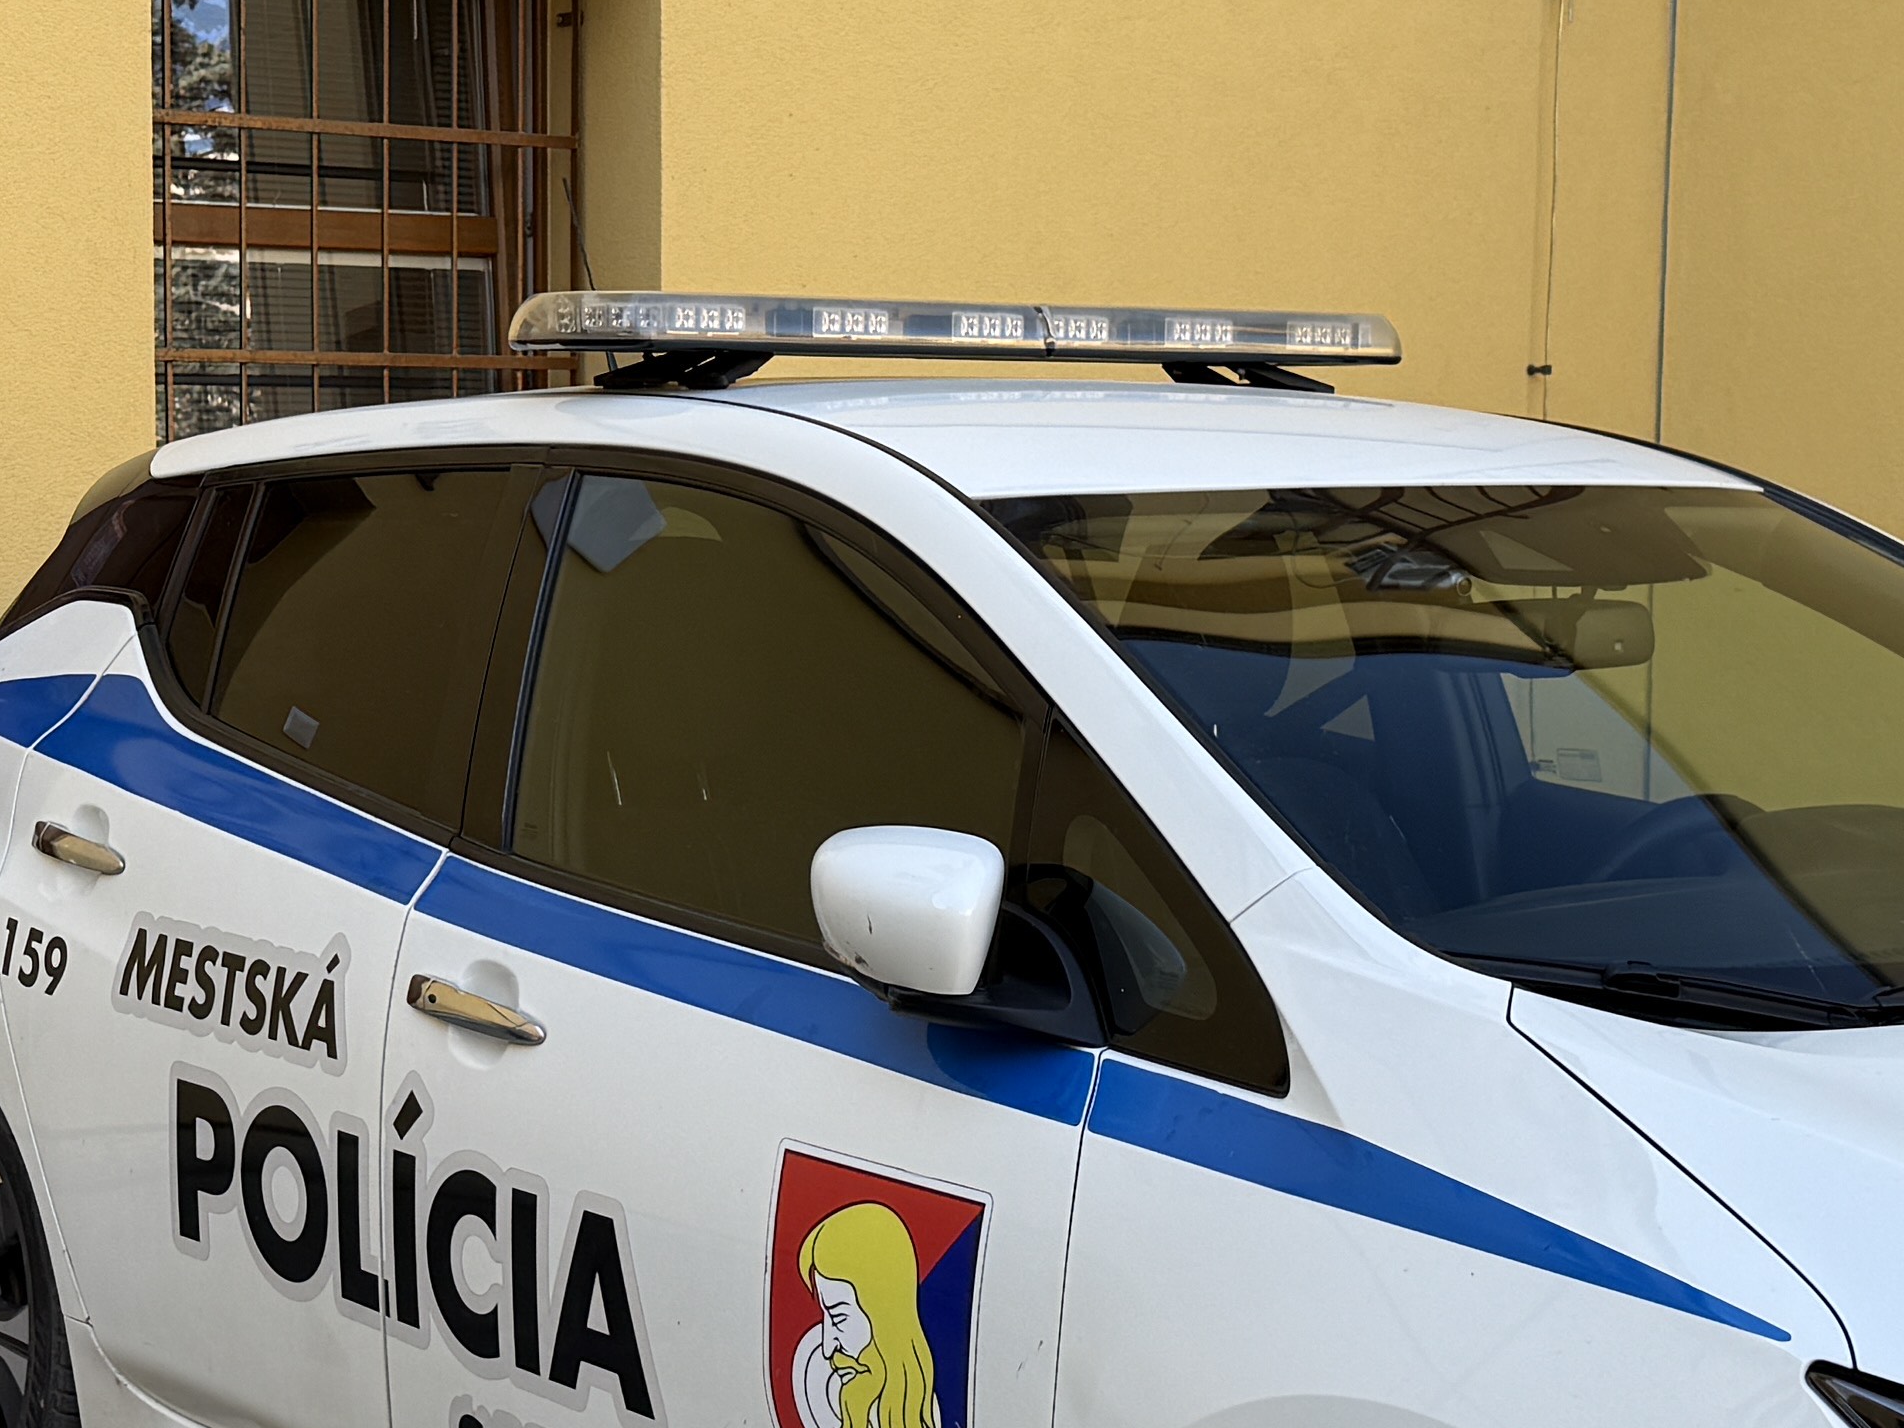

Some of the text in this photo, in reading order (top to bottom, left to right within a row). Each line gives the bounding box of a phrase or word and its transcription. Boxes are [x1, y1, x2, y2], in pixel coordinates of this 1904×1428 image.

[1, 917, 68, 996] 159
[118, 926, 341, 1061] MESTSKÁ
[176, 1078, 656, 1420] POLÍCIA
